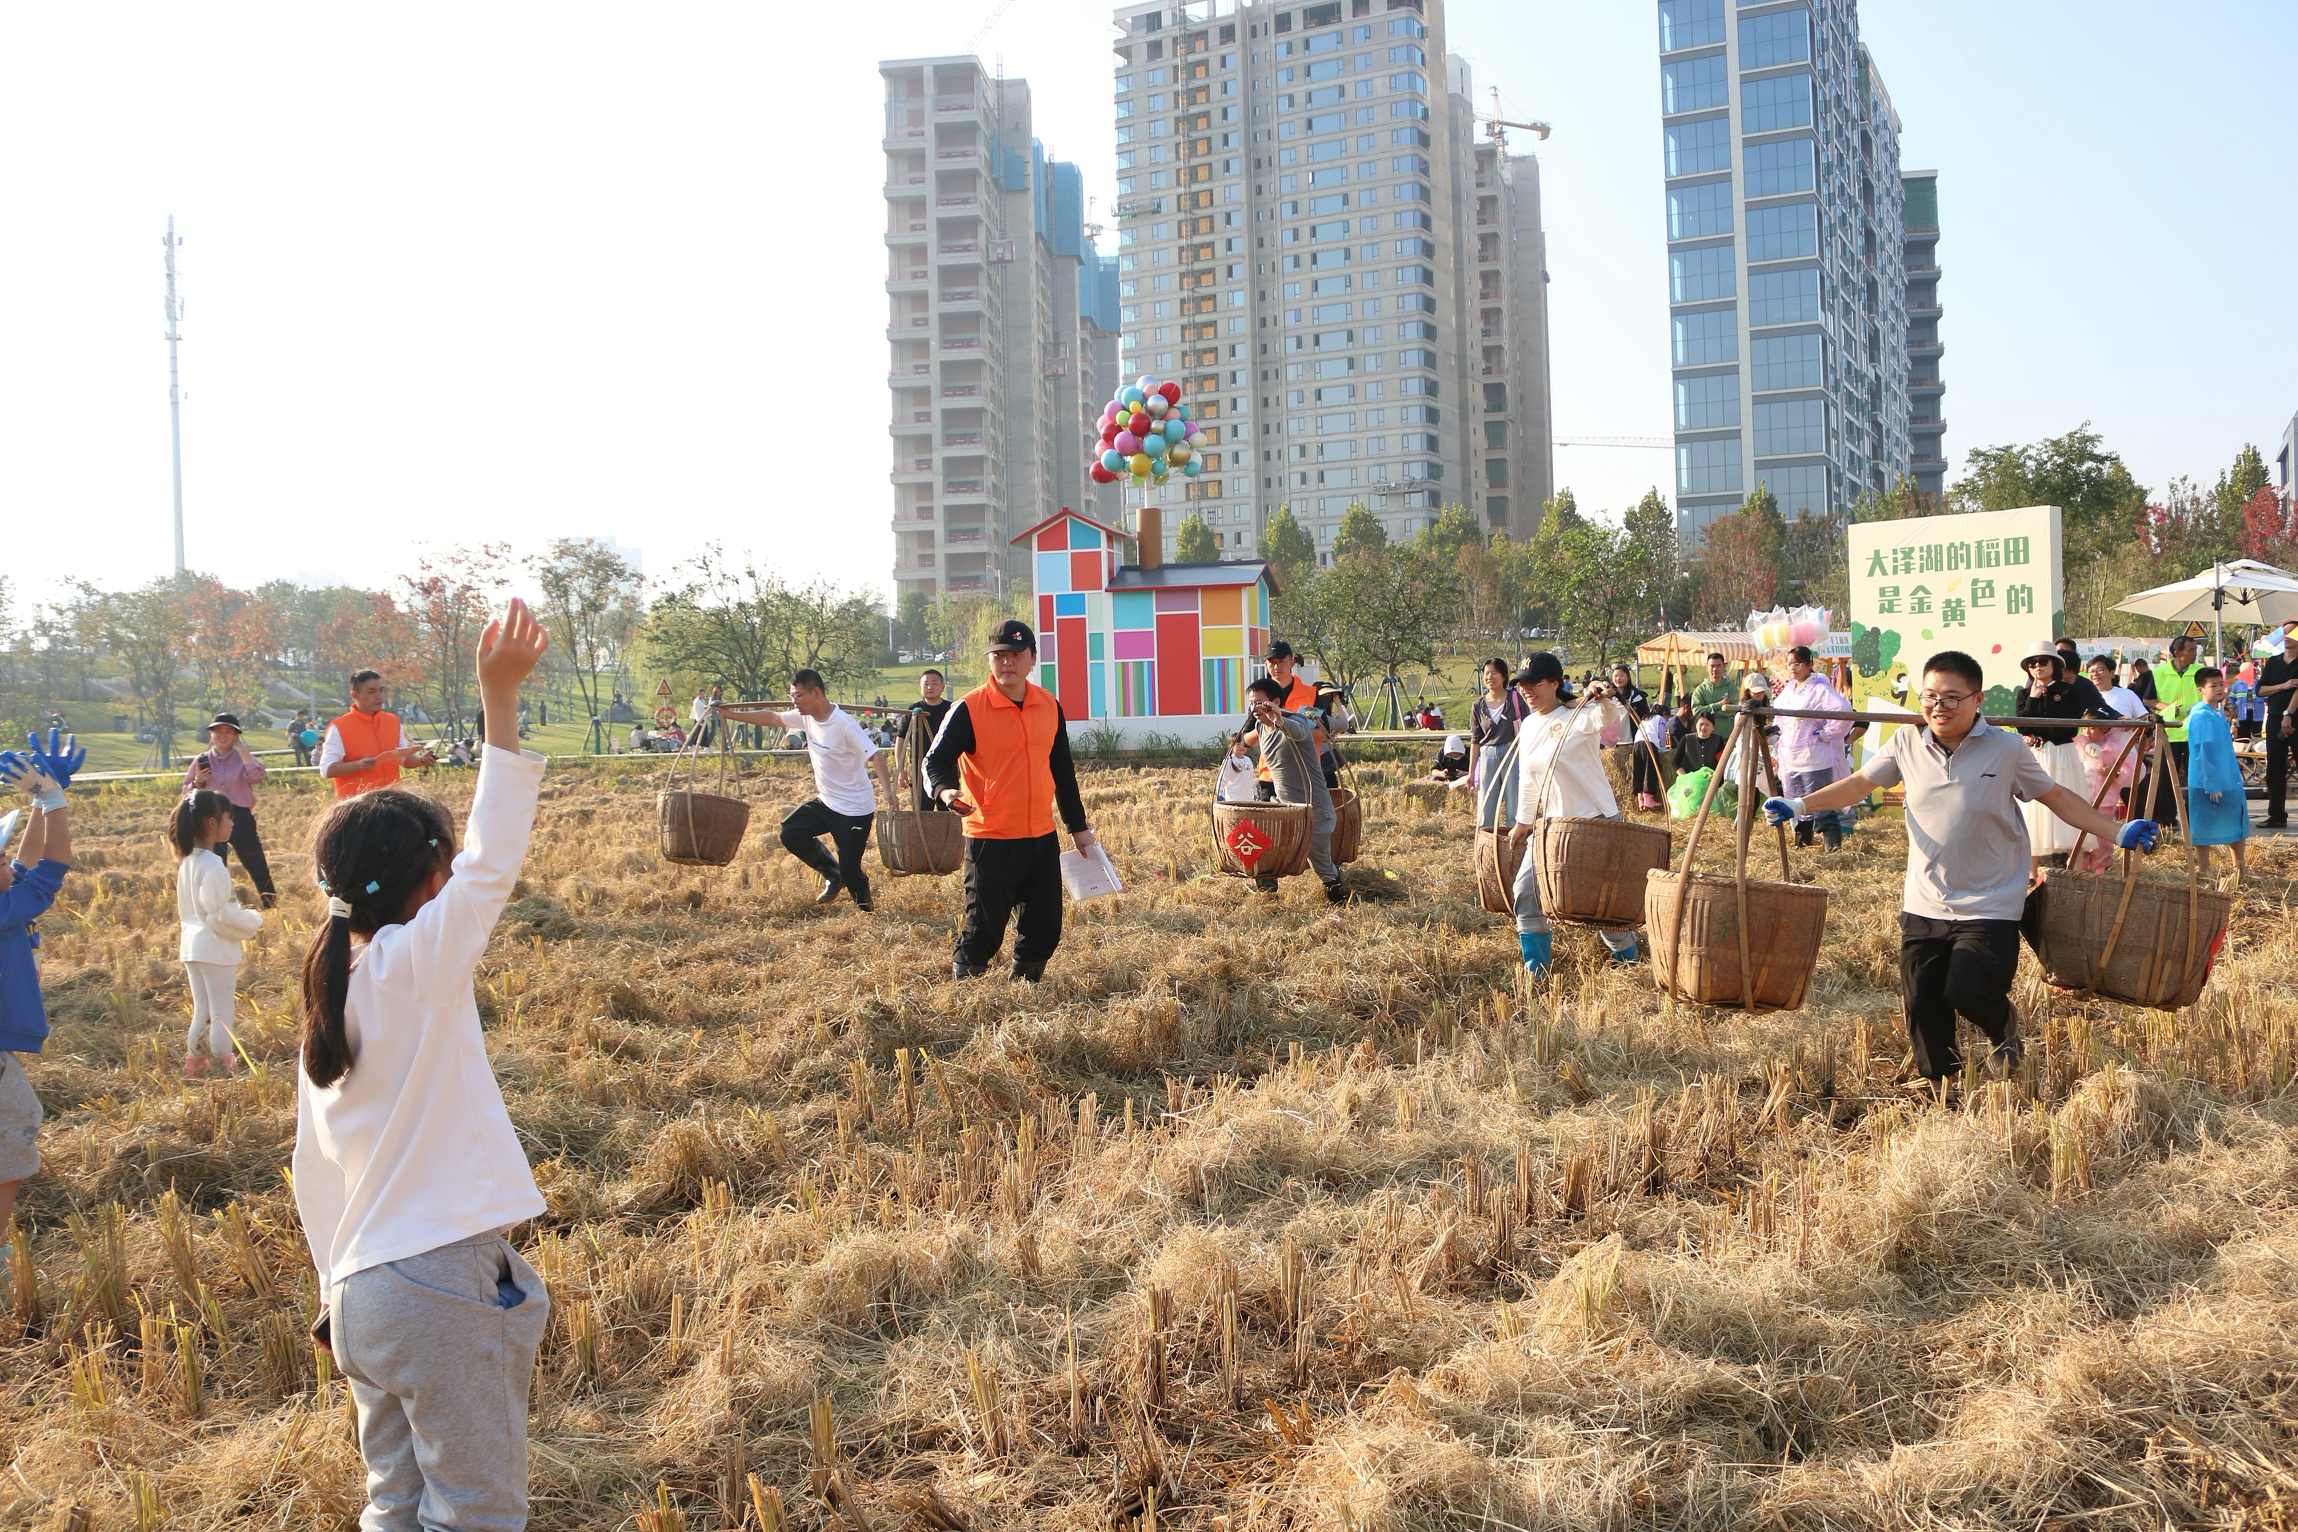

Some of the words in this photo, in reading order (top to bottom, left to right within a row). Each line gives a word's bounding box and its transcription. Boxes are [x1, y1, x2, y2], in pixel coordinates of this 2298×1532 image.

[1866, 536, 2030, 577] 大泽湖的稻田
[1877, 578, 2034, 628] 是金黄色的
[1234, 832, 1263, 855] 谷
